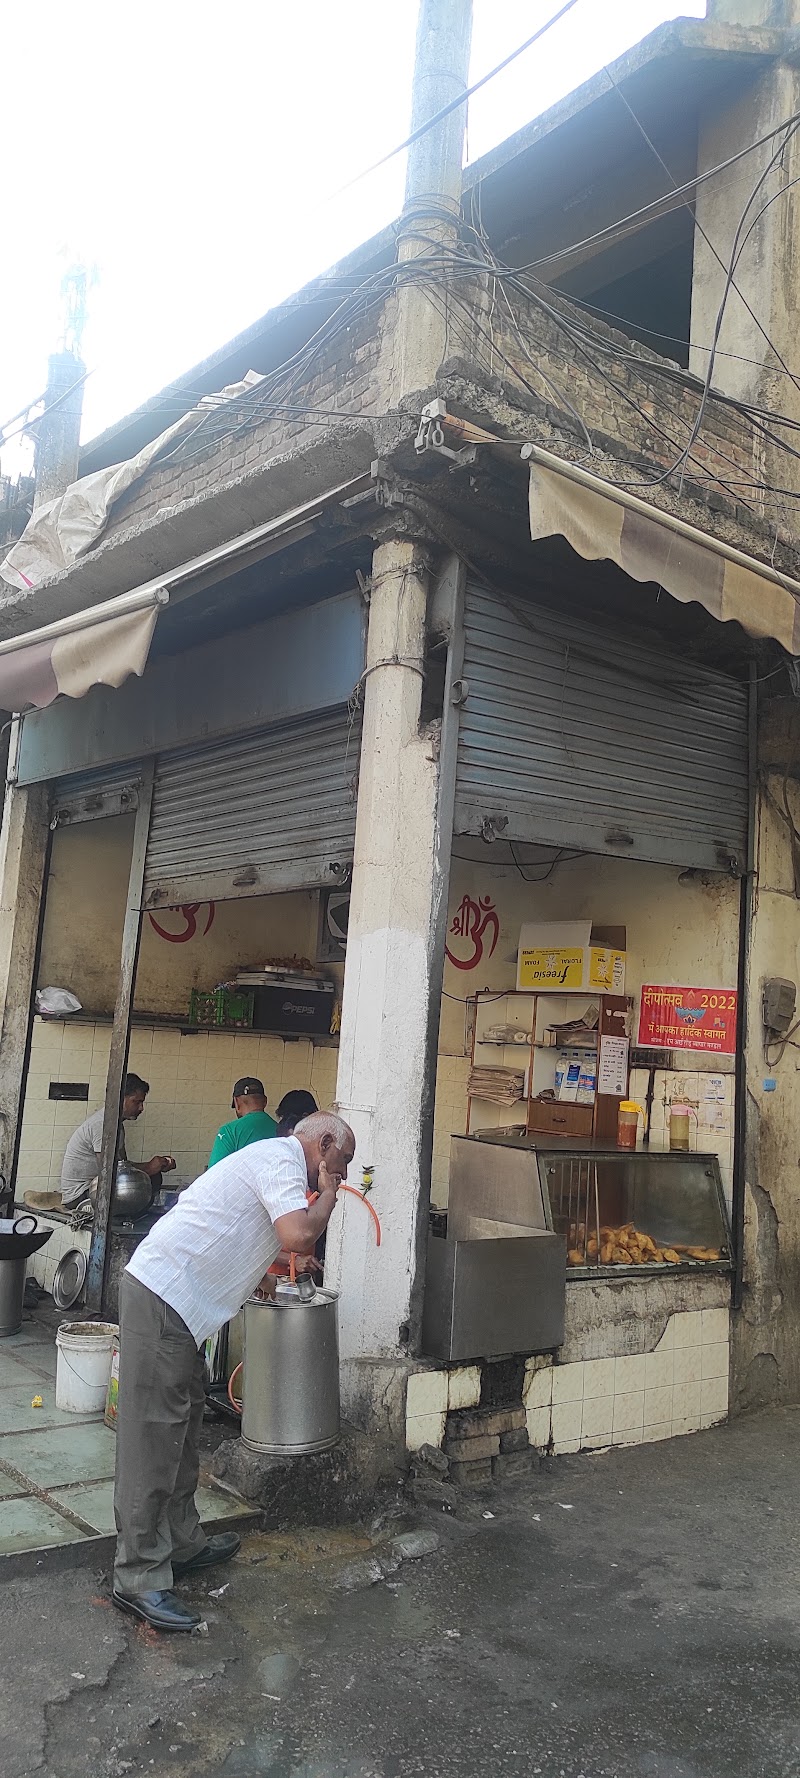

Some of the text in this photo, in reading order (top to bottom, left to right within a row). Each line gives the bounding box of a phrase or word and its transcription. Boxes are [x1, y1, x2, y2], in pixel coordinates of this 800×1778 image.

[533, 965, 570, 984] freesia
[643, 987, 736, 1010] दीपोत्सव 2022
[290, 1004, 315, 1015] PEPSI
[655, 1023, 680, 1036] आपका
[680, 1024, 703, 1039] हार्दिक
[703, 1028, 727, 1041] स्वागत
